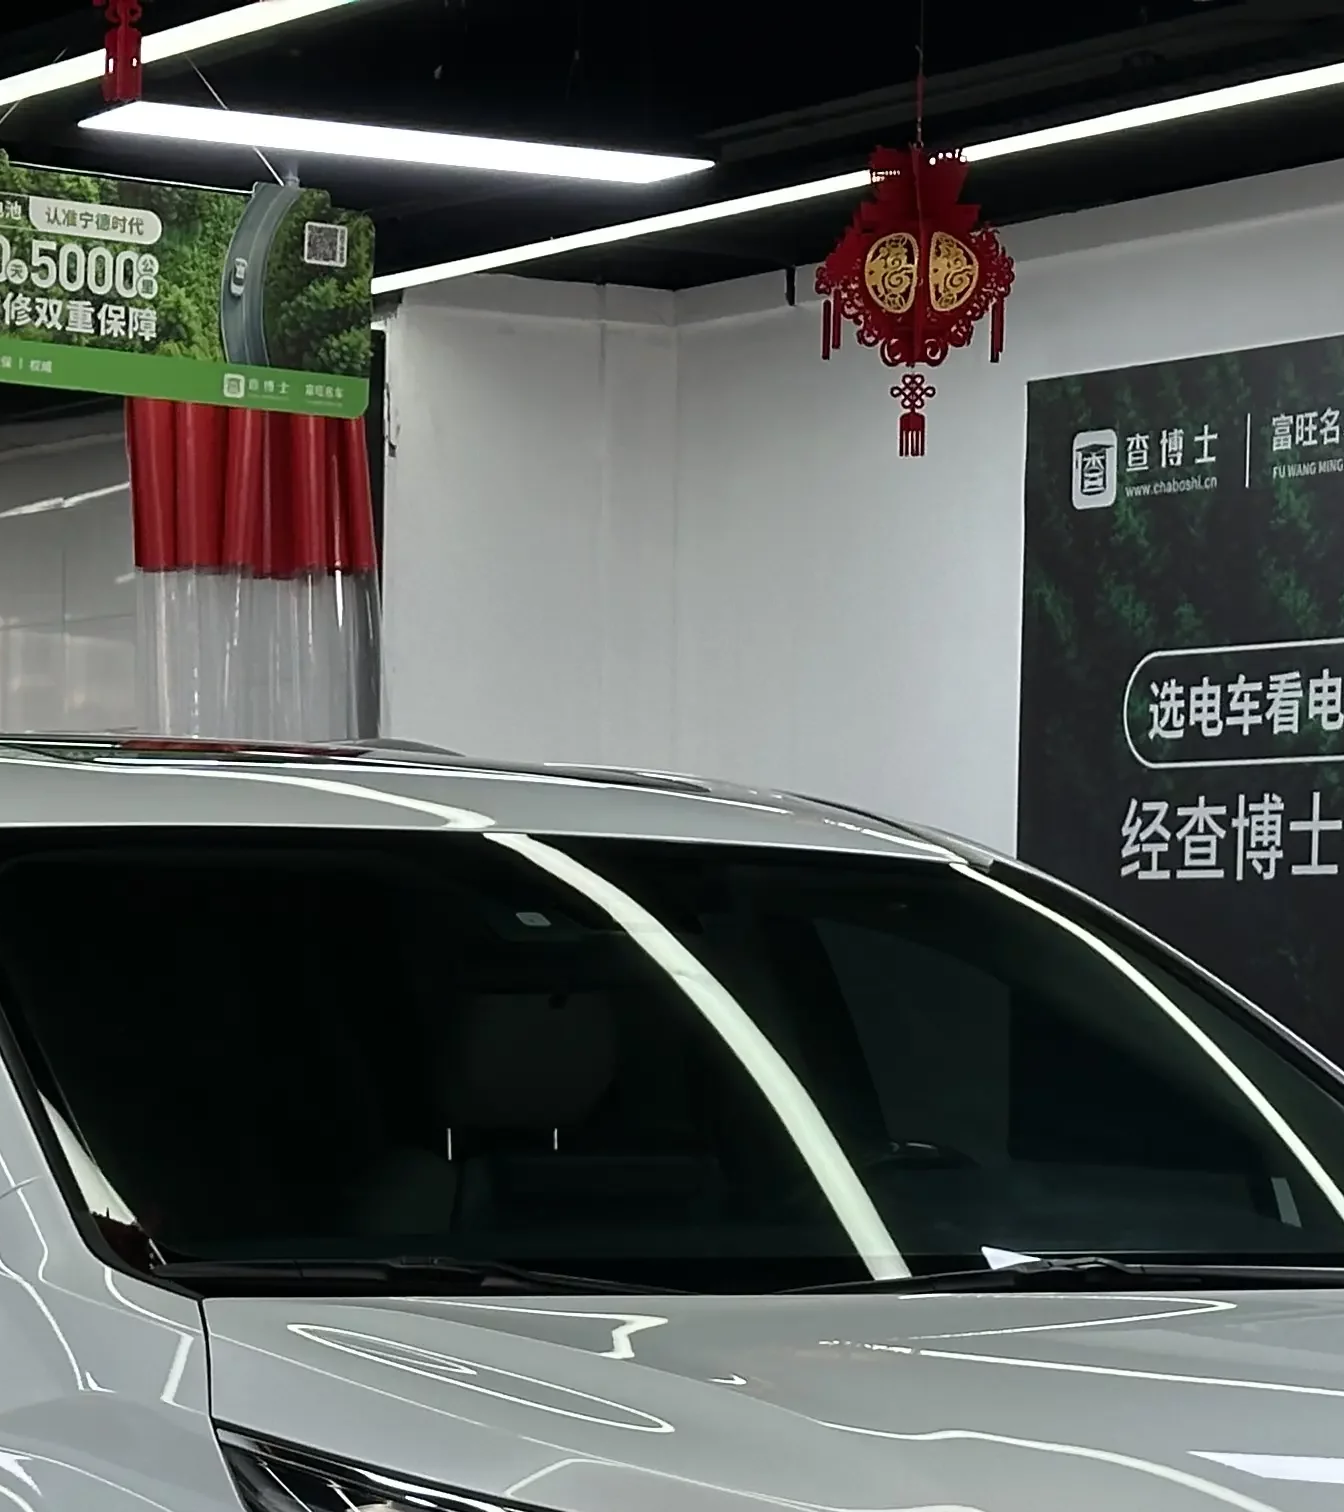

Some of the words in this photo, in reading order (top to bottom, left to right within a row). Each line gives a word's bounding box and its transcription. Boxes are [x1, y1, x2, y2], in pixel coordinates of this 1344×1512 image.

[45, 206, 145, 236] 认准宁德时代
[30, 238, 138, 298] 5000
[1126, 424, 1218, 472] 查博士
[1272, 465, 1286, 479] FU
[1287, 462, 1317, 478] WANG
[1318, 458, 1344, 474] MING
[1124, 475, 1218, 498] www.chaboshi.cn
